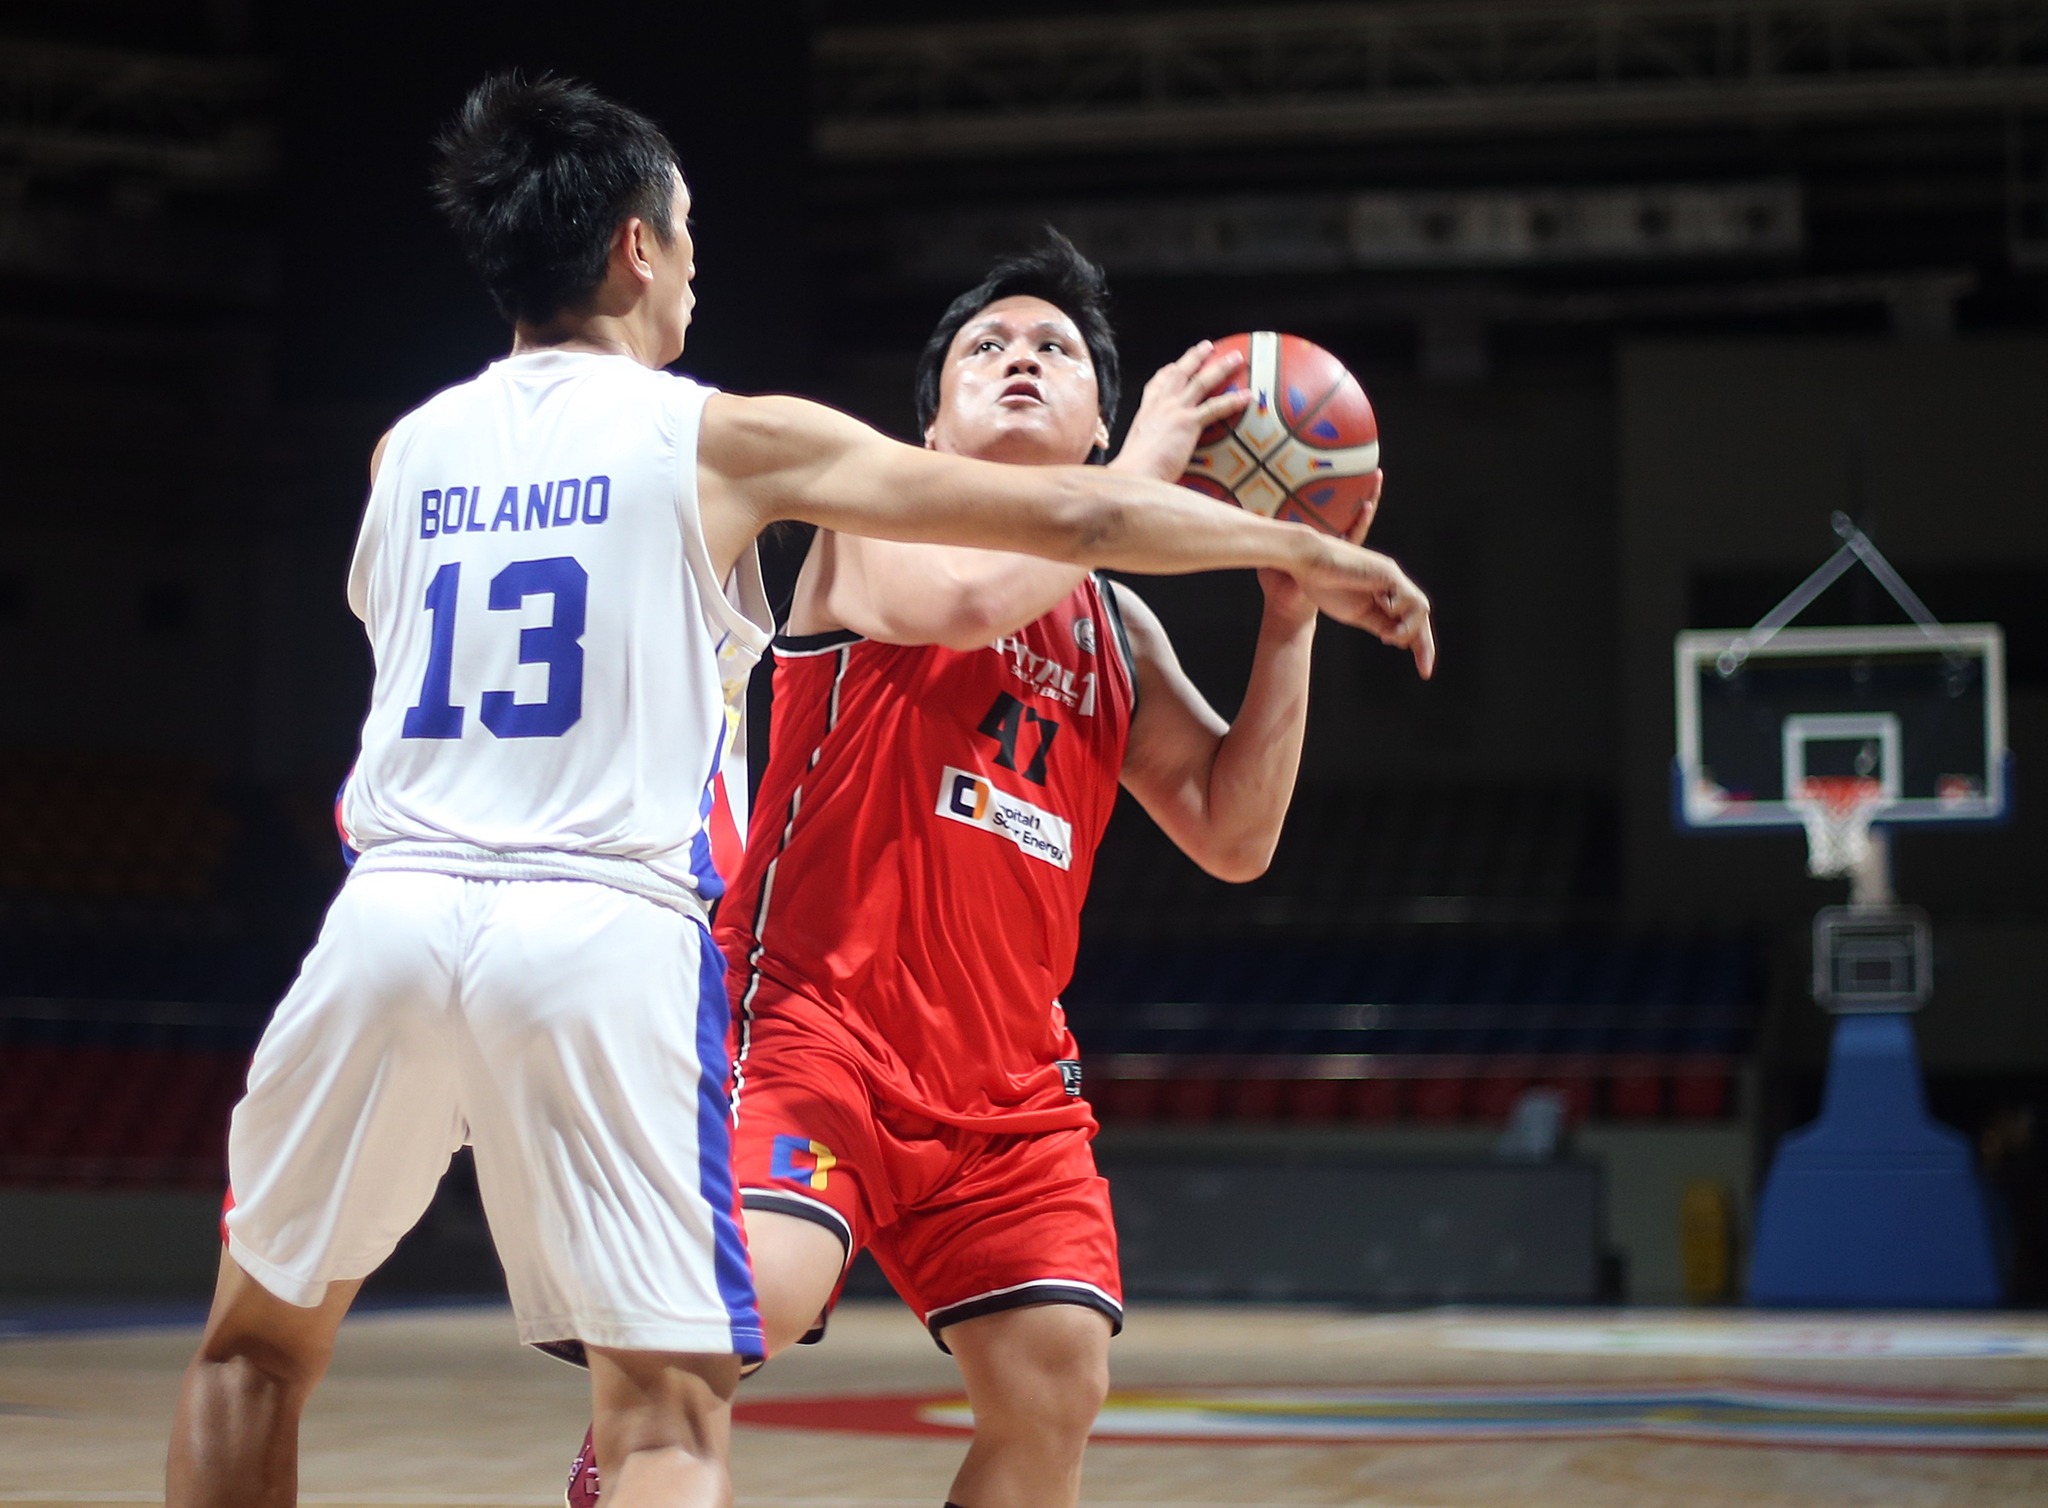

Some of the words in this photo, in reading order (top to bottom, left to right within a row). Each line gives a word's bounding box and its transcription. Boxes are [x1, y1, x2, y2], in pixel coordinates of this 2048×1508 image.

[420, 475, 611, 539] BOLANDO
[401, 556, 588, 739] 13
[977, 690, 1060, 787] 47
